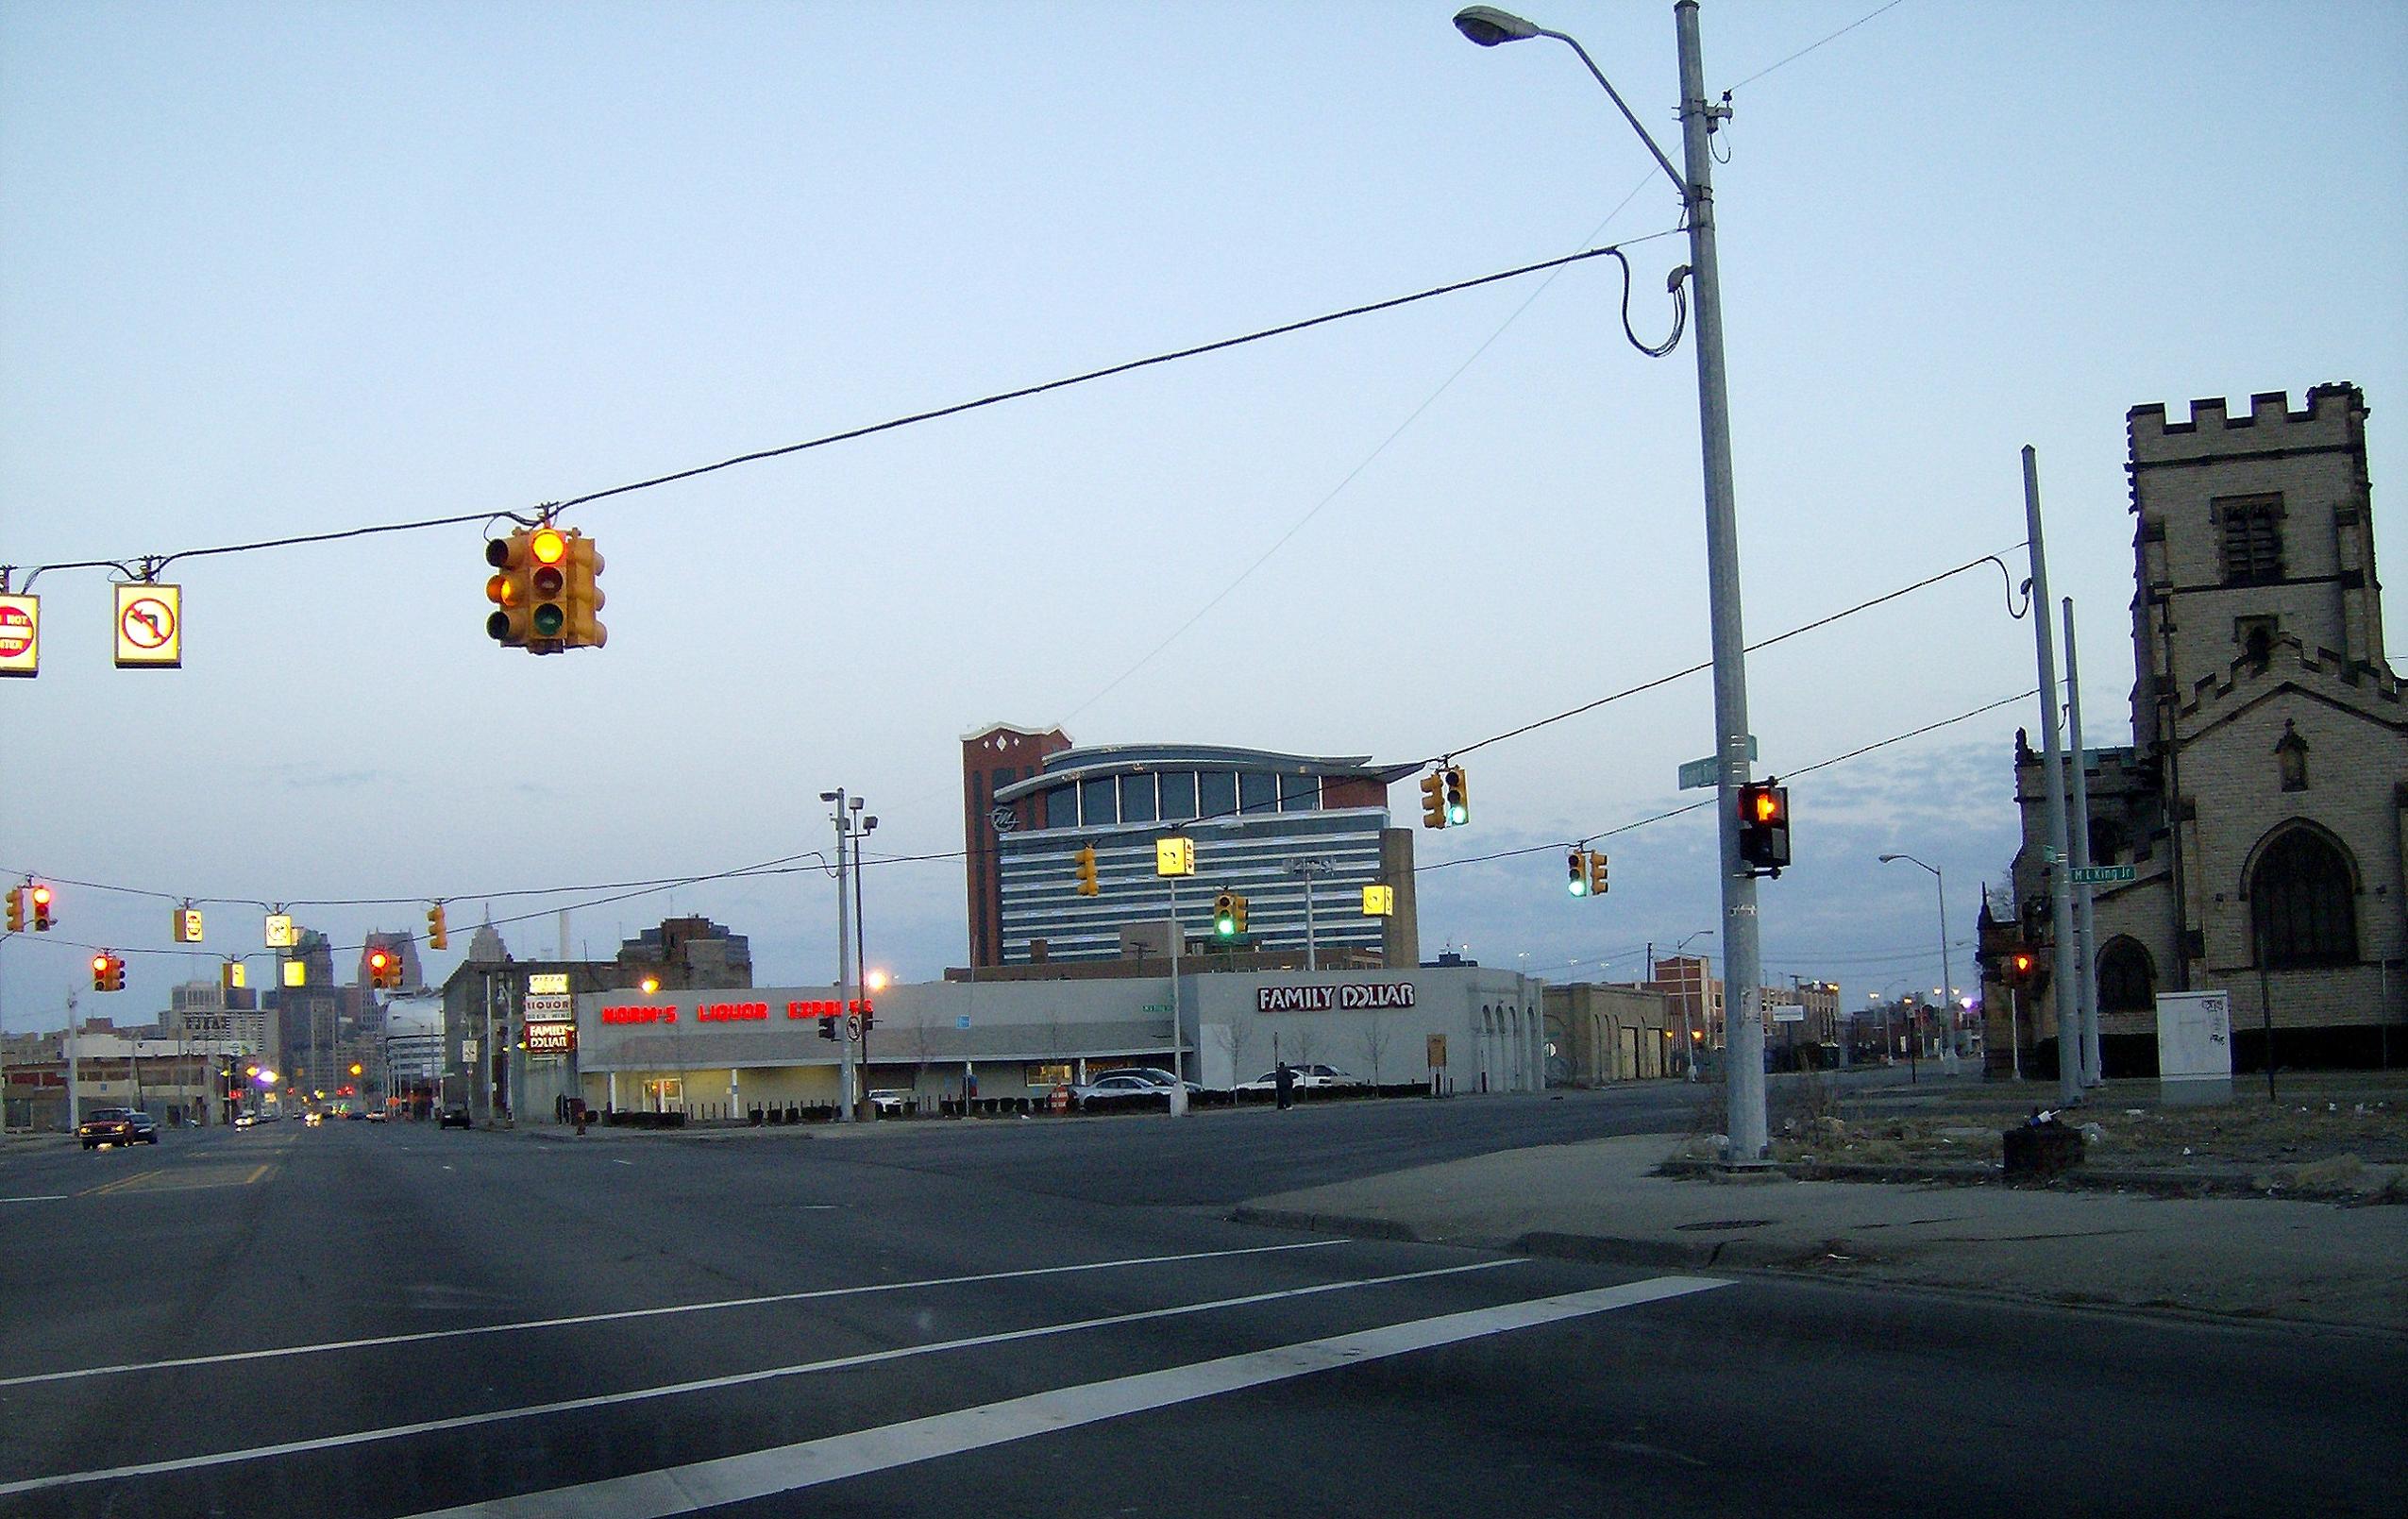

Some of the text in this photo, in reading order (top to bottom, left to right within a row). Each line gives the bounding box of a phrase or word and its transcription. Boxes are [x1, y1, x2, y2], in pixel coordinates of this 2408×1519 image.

[2095, 869, 2117, 881] King
[1258, 984, 1415, 1010] FAMILY DOLLAR
[602, 1005, 677, 1024] NORM'S
[698, 1004, 769, 1021] LIQUOR
[530, 1025, 567, 1037] FAMILY
[530, 1037, 567, 1048] DOLLAR
